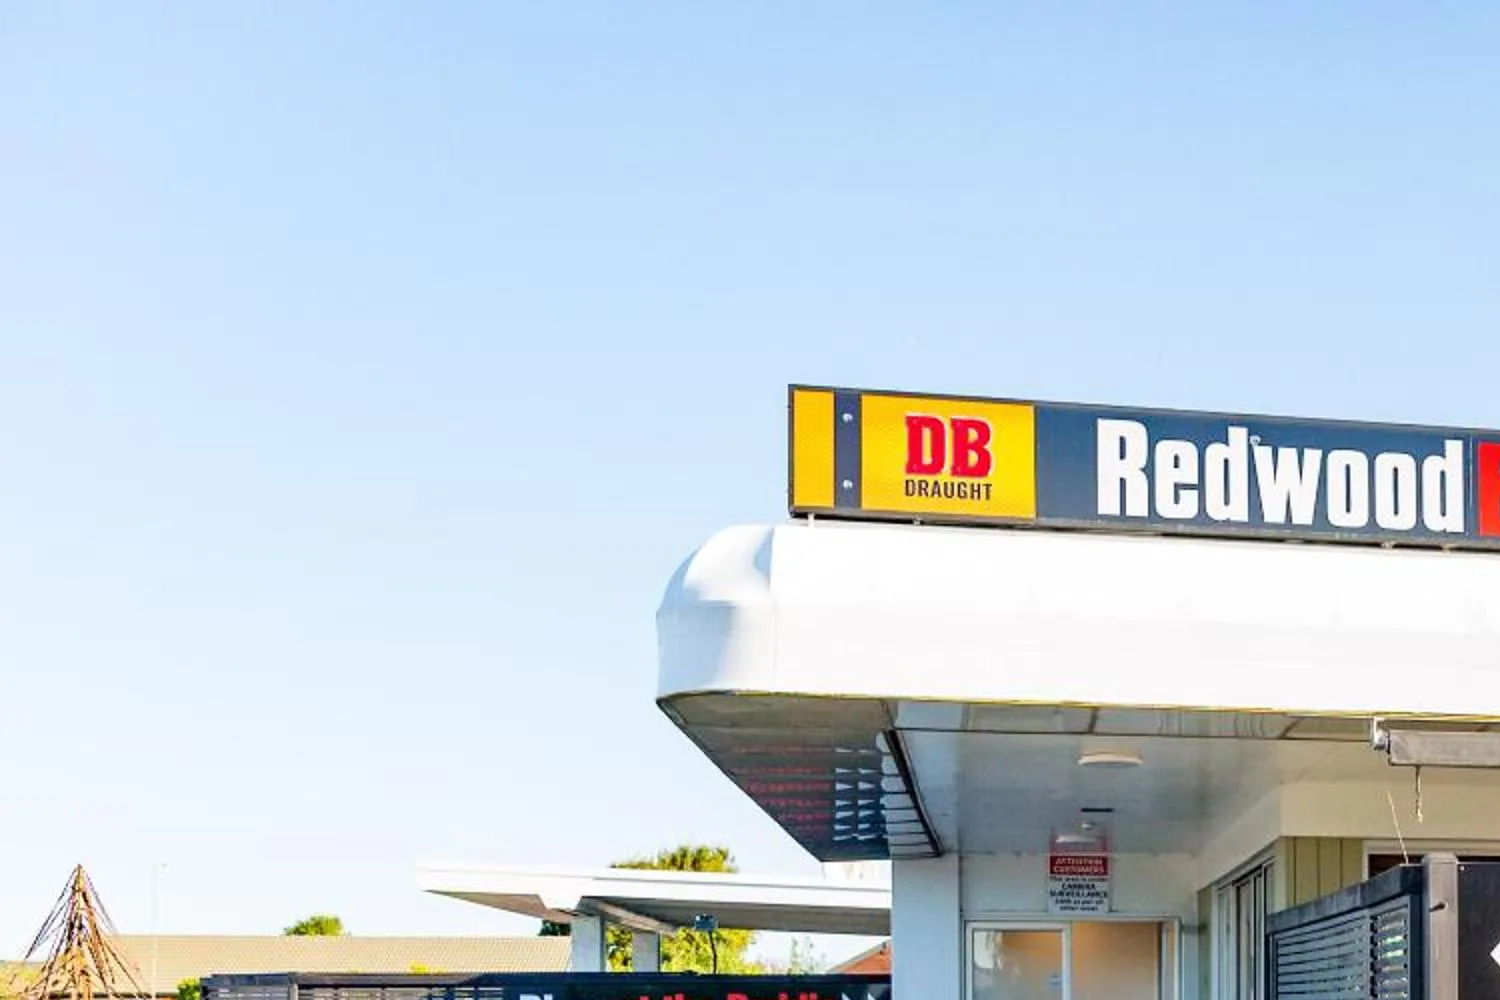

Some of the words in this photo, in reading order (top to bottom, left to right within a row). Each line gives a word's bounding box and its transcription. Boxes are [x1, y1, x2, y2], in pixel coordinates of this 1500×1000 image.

[905, 412, 993, 478] DB
[1096, 417, 1466, 534] Redwood
[905, 479, 993, 501] DRAUGHT
